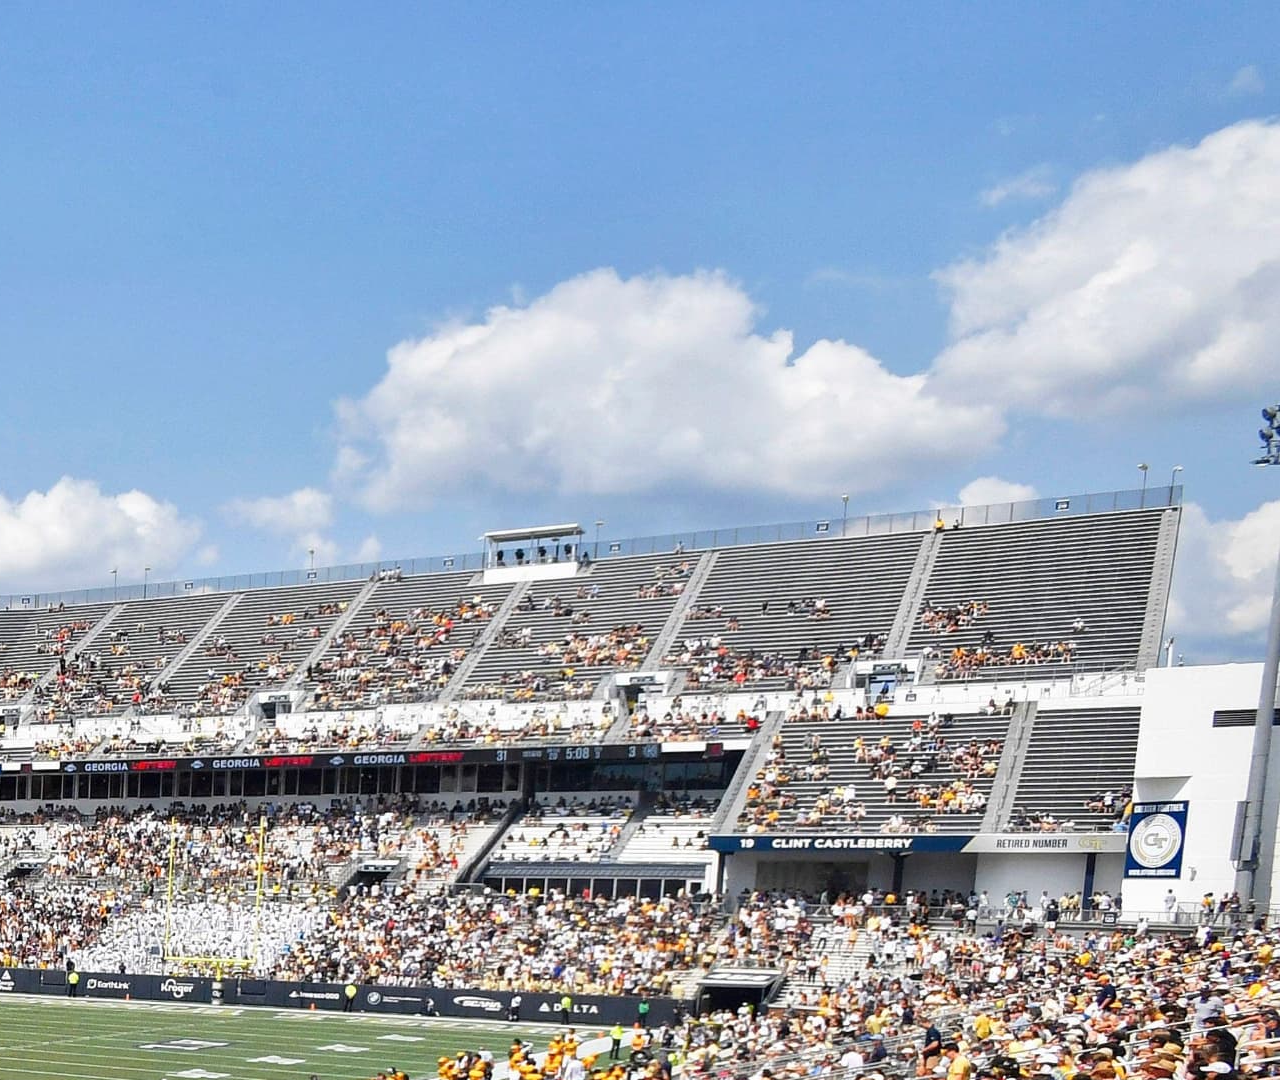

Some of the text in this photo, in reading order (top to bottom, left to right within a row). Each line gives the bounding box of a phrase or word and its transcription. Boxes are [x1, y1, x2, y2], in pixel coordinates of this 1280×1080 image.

[353, 752, 464, 764] GEORGIA LOTTERY
[496, 750, 507, 761] 31
[565, 747, 590, 760] 5:08
[628, 747, 636, 758] 3
[84, 760, 177, 772] GEORGIA LOTTERY
[212, 757, 314, 768] GEORGIA LOTTERY
[740, 838, 913, 848] 19 CLINT CASTLEBERRY
[996, 839, 1030, 848] RETIRED
[1032, 839, 1068, 848] NUMBER
[1144, 833, 1168, 848] GT
[97, 981, 129, 990] EarthLink
[161, 979, 194, 998] Kroger
[554, 1004, 599, 1014] DLTA
